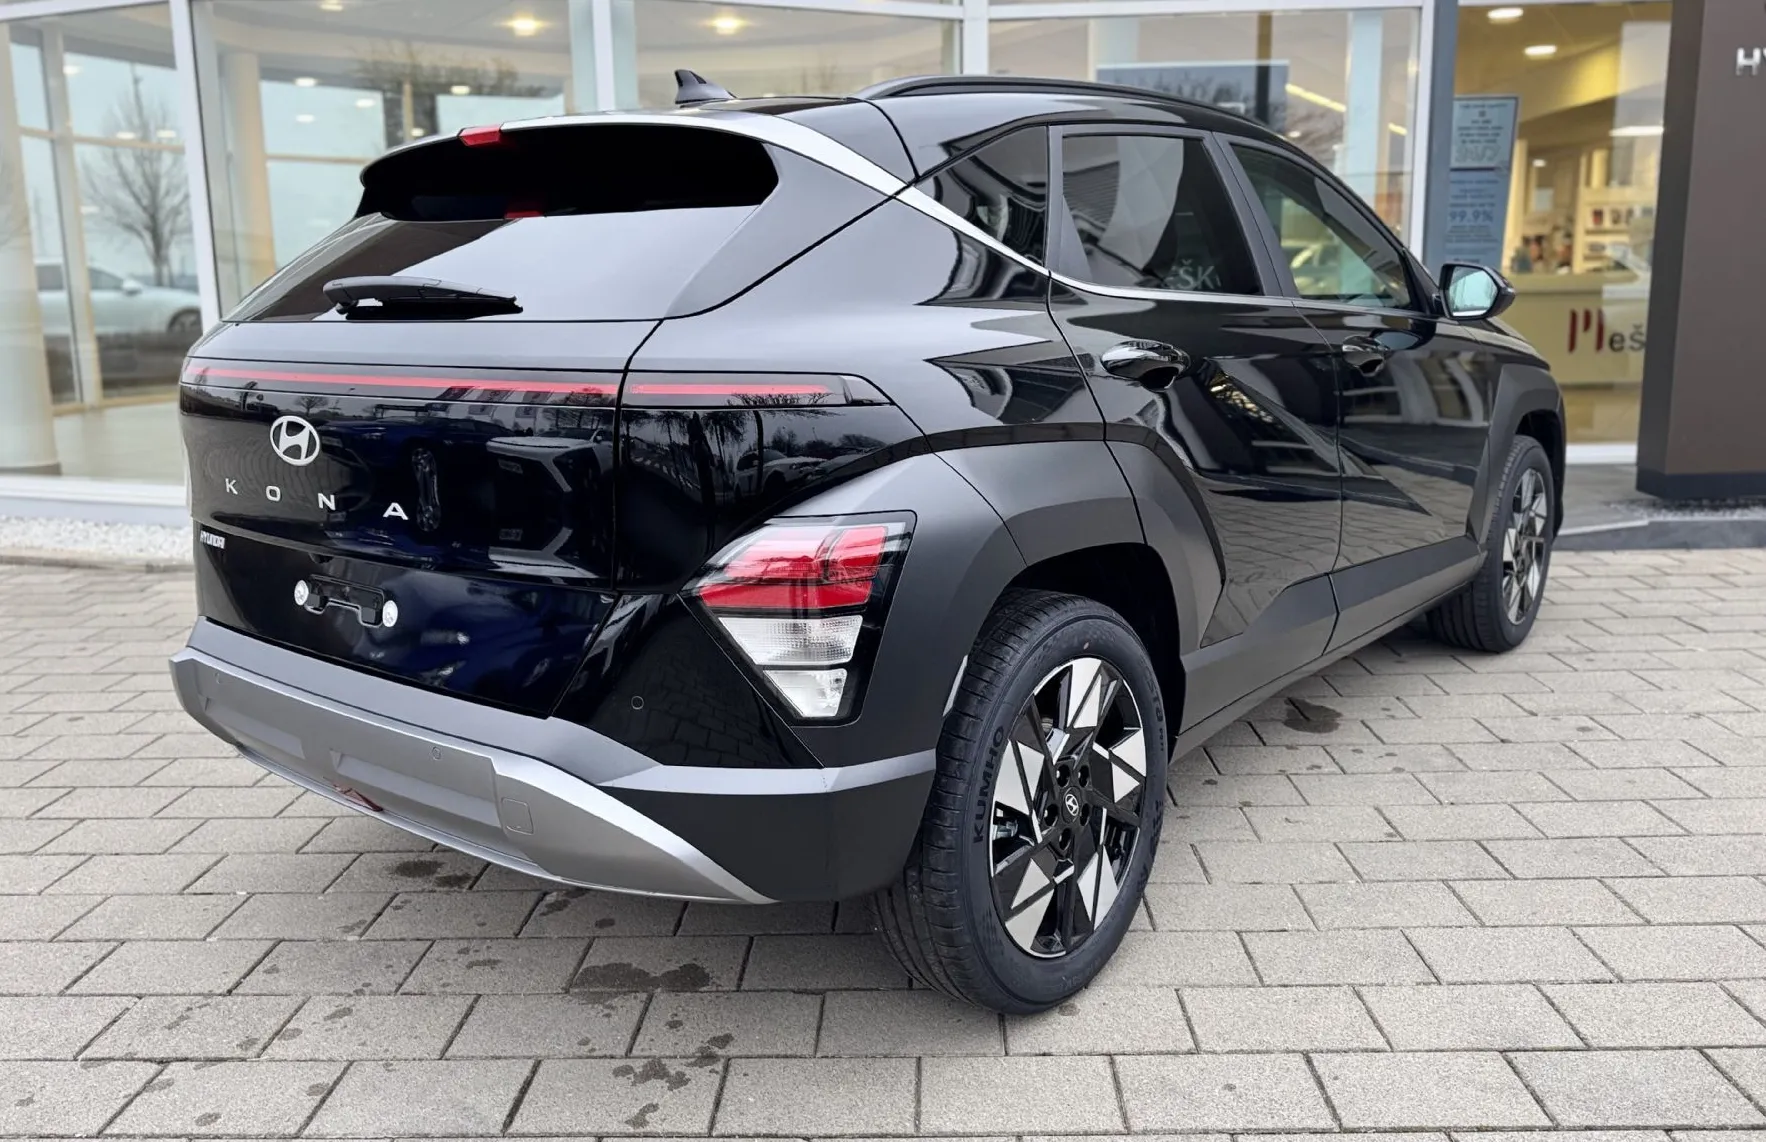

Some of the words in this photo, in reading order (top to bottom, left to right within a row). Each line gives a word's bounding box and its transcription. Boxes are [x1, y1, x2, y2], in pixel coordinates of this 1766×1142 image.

[1736, 47, 1766, 76] H
[225, 477, 409, 521] KONA
[973, 725, 1004, 844] KUMHO
